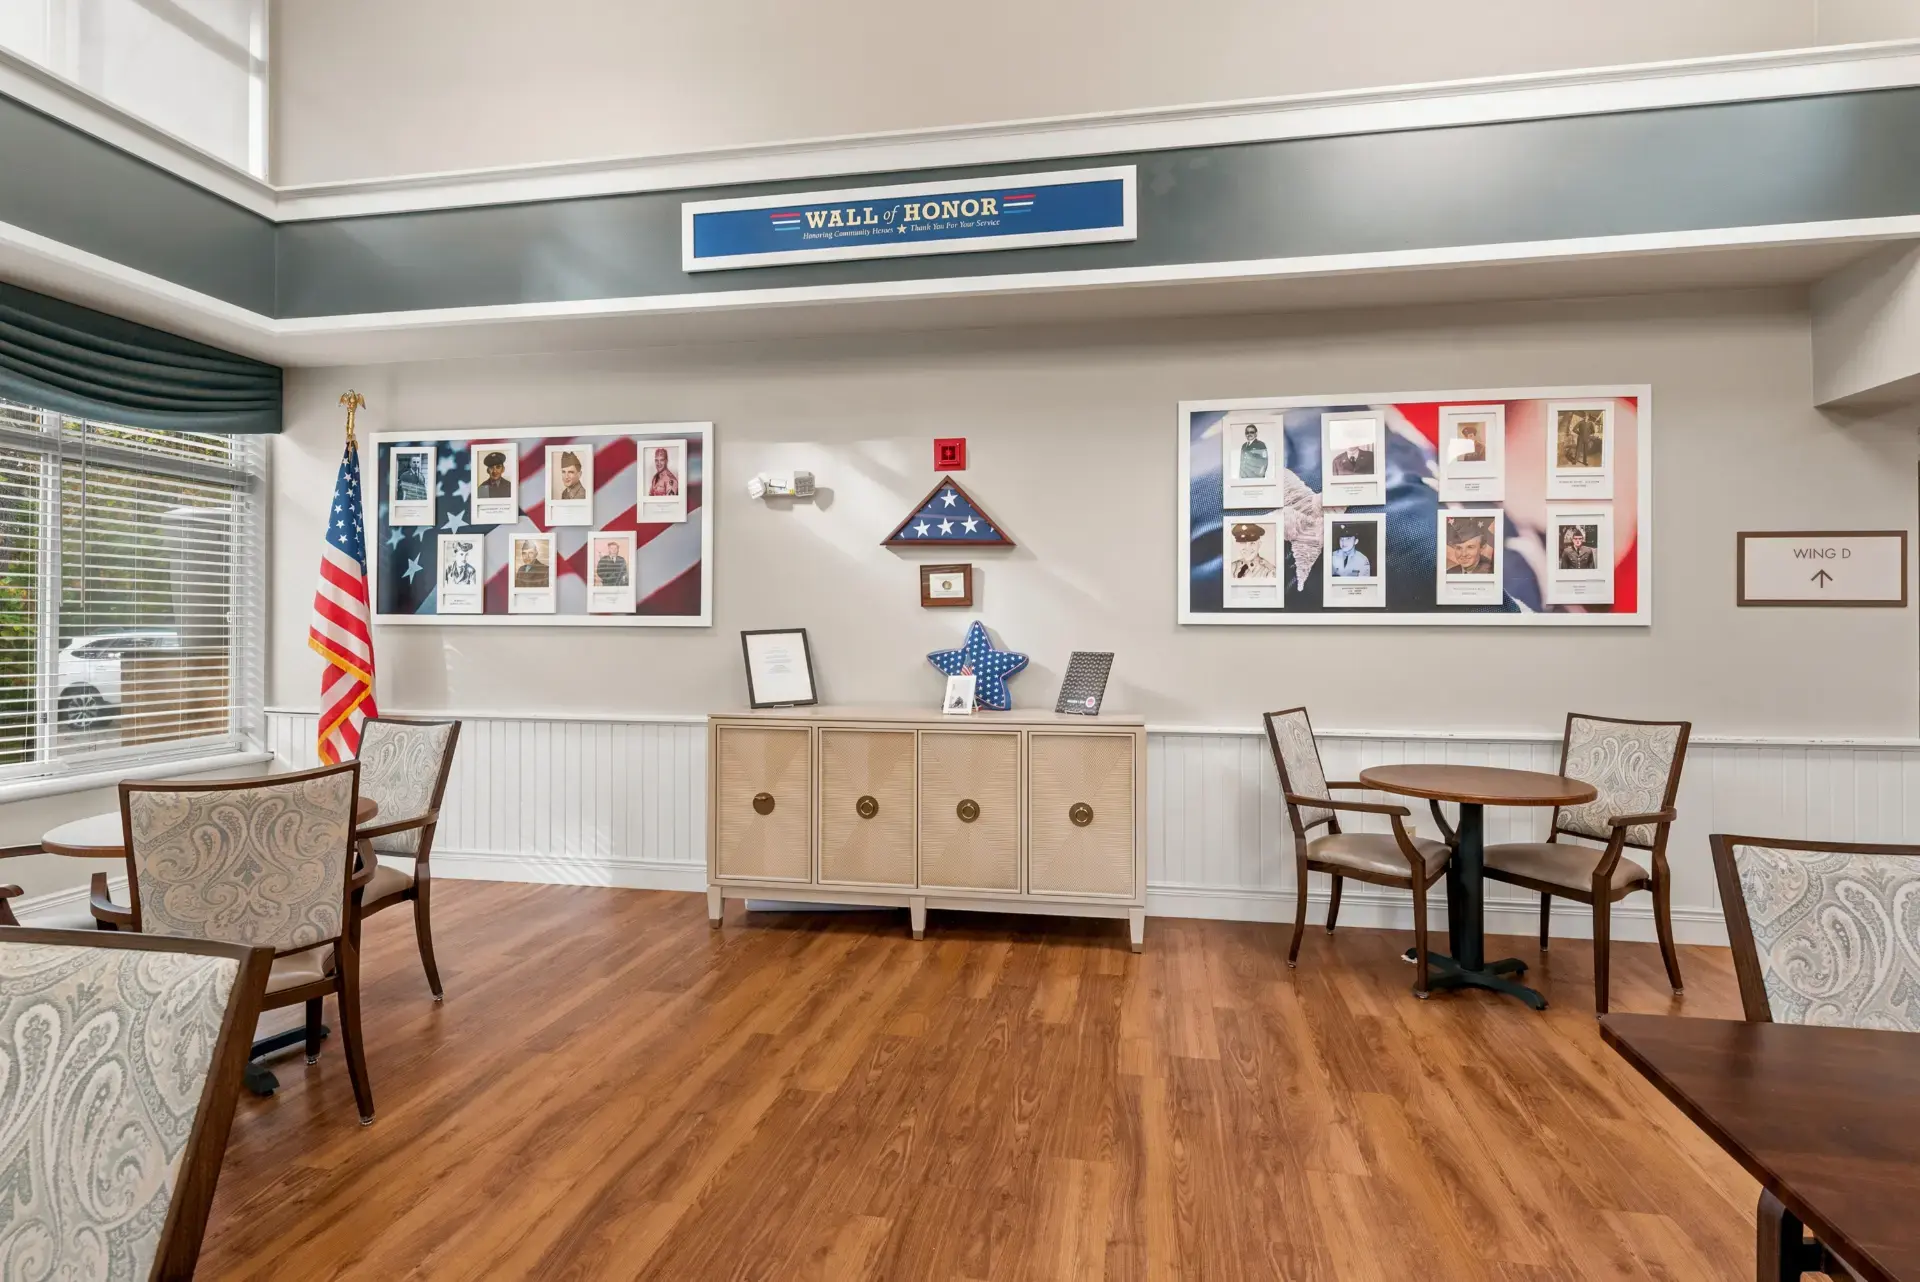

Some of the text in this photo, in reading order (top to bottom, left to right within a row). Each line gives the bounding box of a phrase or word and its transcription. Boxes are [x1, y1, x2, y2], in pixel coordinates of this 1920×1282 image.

[805, 197, 999, 229] WALL of HONOR
[803, 231, 833, 240] Honoring
[834, 228, 870, 238] Community
[872, 227, 894, 235] Heroes
[911, 223, 931, 231] Thank
[946, 221, 958, 229] For
[960, 220, 974, 228] Your
[976, 219, 1000, 227] Service
[1793, 548, 1851, 559] WING D
